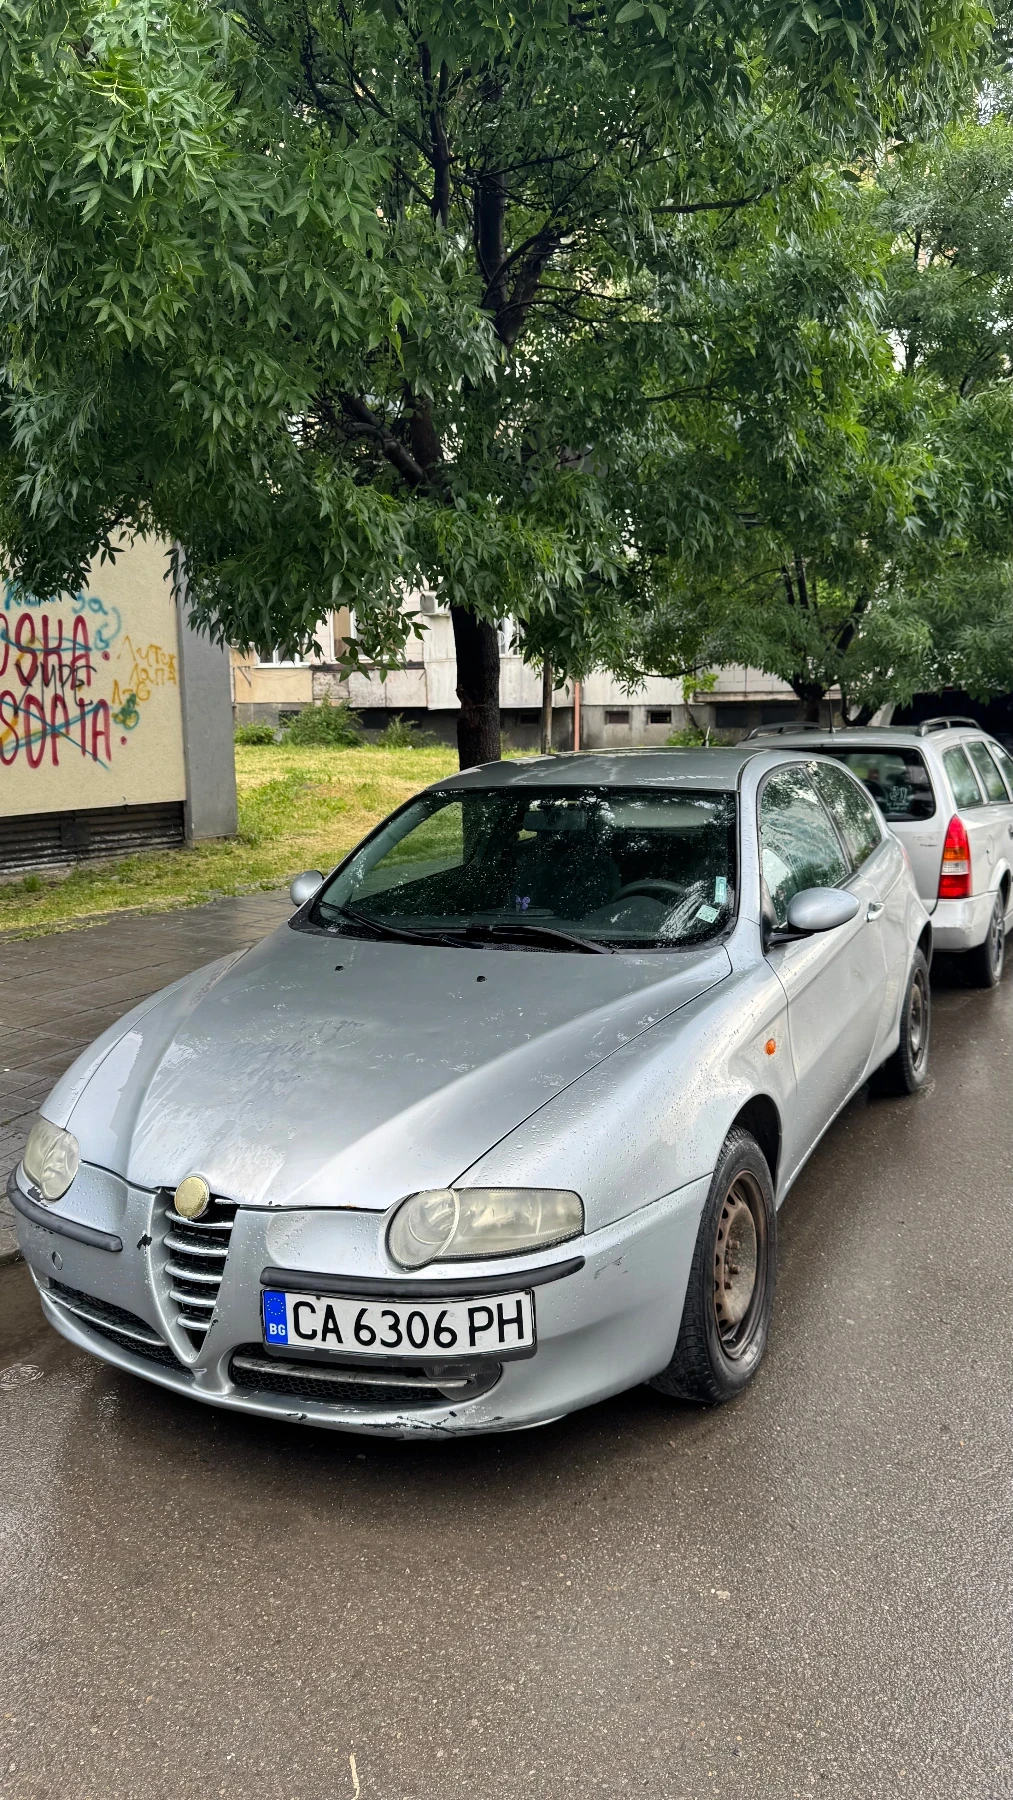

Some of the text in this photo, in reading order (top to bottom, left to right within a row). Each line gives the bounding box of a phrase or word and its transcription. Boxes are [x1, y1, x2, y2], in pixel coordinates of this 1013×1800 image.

[269, 1323, 286, 1336] BG
[293, 1299, 525, 1349] CA 6306 PH
